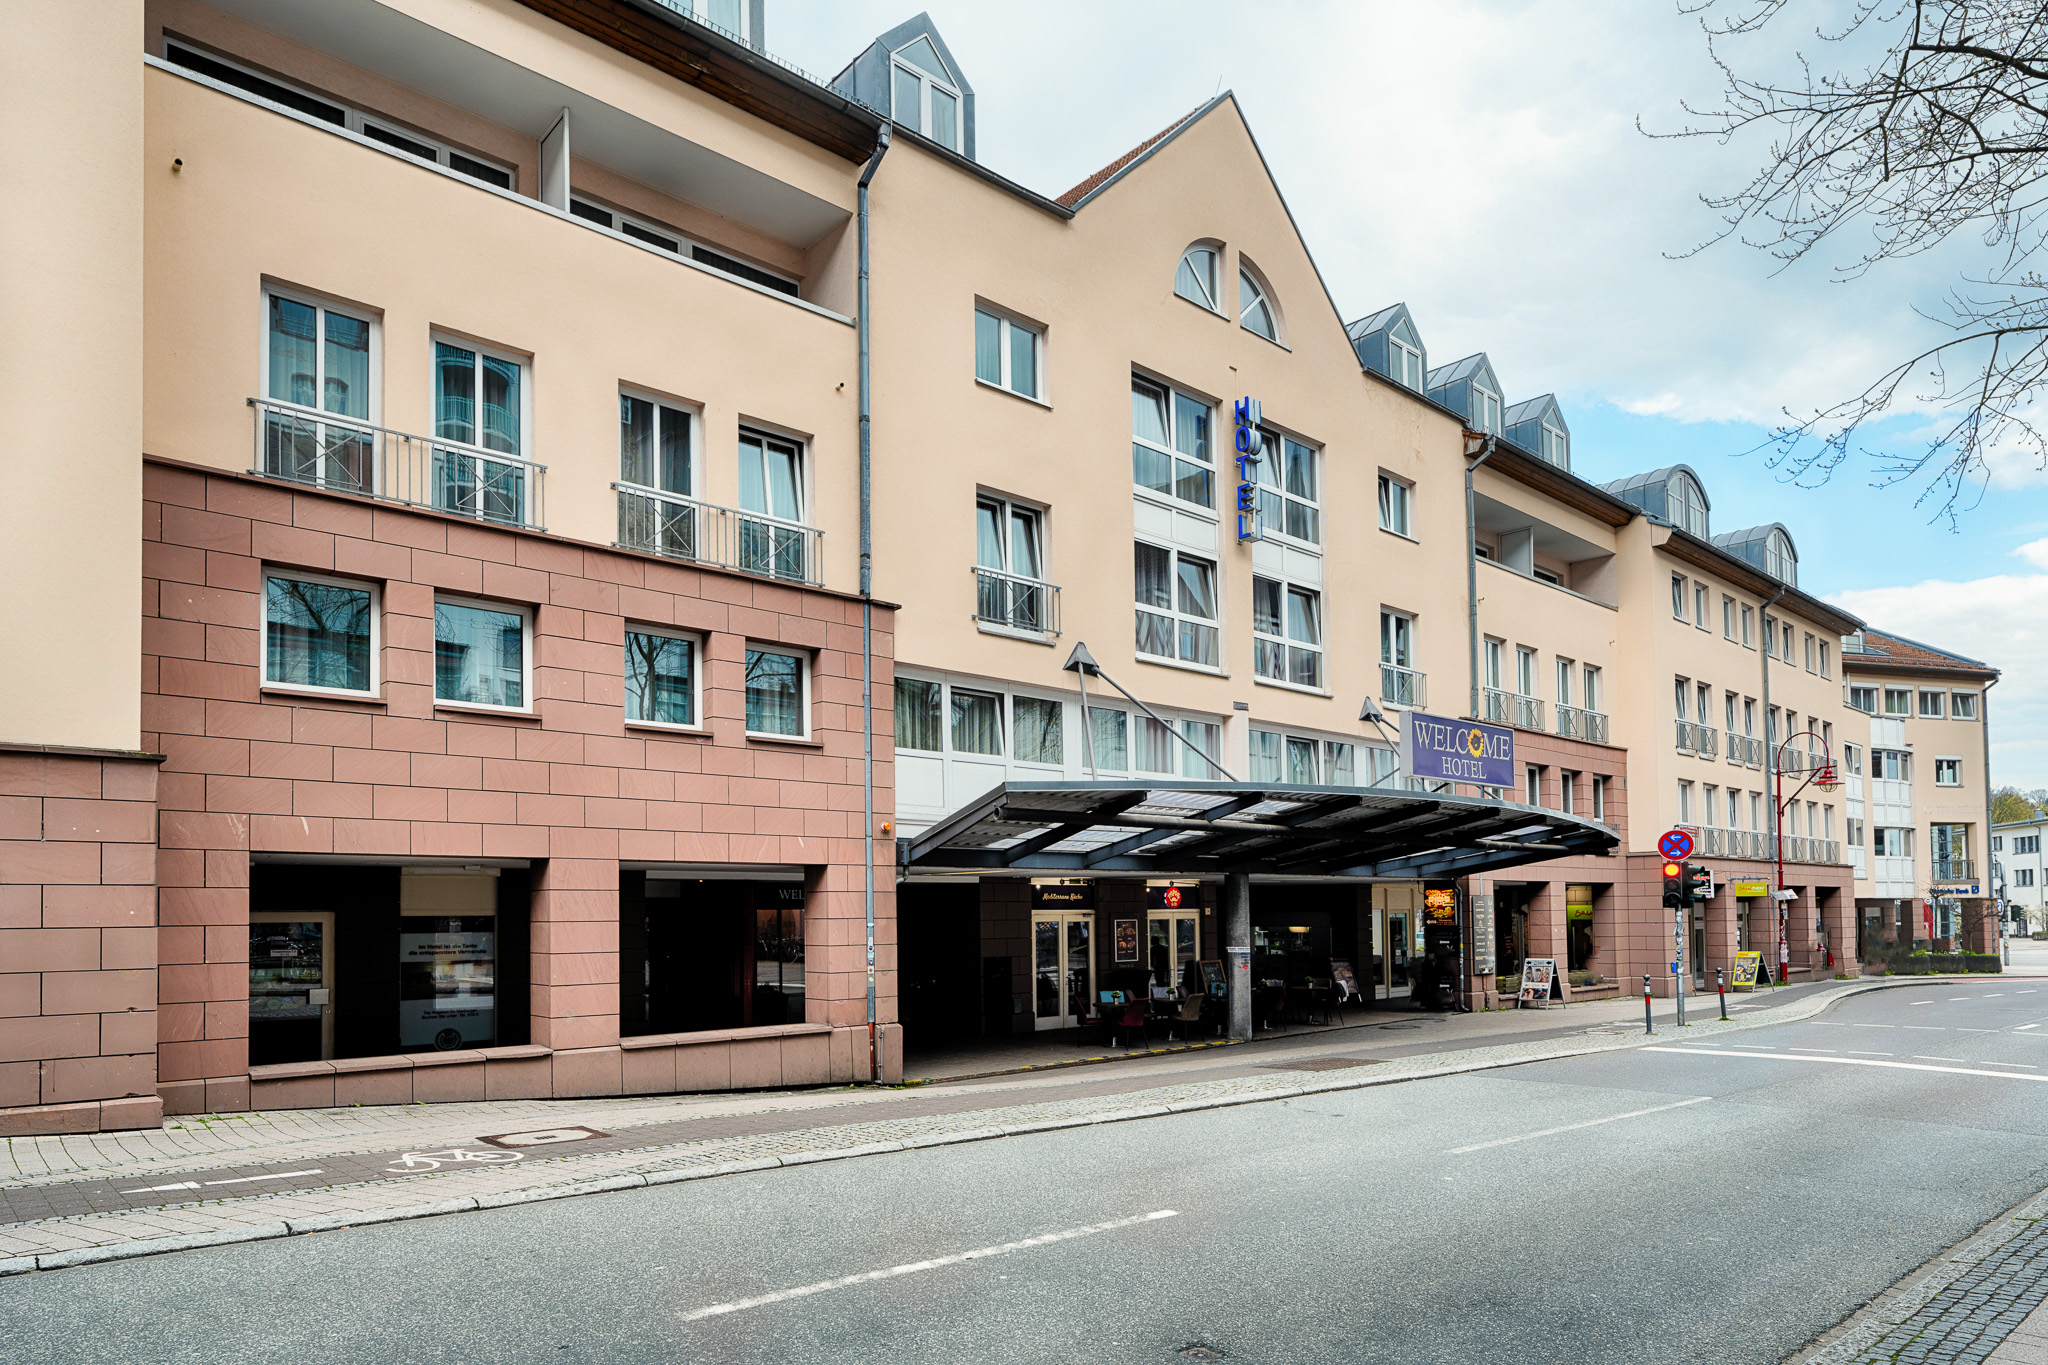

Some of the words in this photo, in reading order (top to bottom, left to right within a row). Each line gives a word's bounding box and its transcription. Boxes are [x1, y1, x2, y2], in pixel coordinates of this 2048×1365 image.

[1235, 396, 1254, 541] HOTEL
[1413, 721, 1511, 761] WELCOME
[1441, 757, 1487, 779] HOTEL
